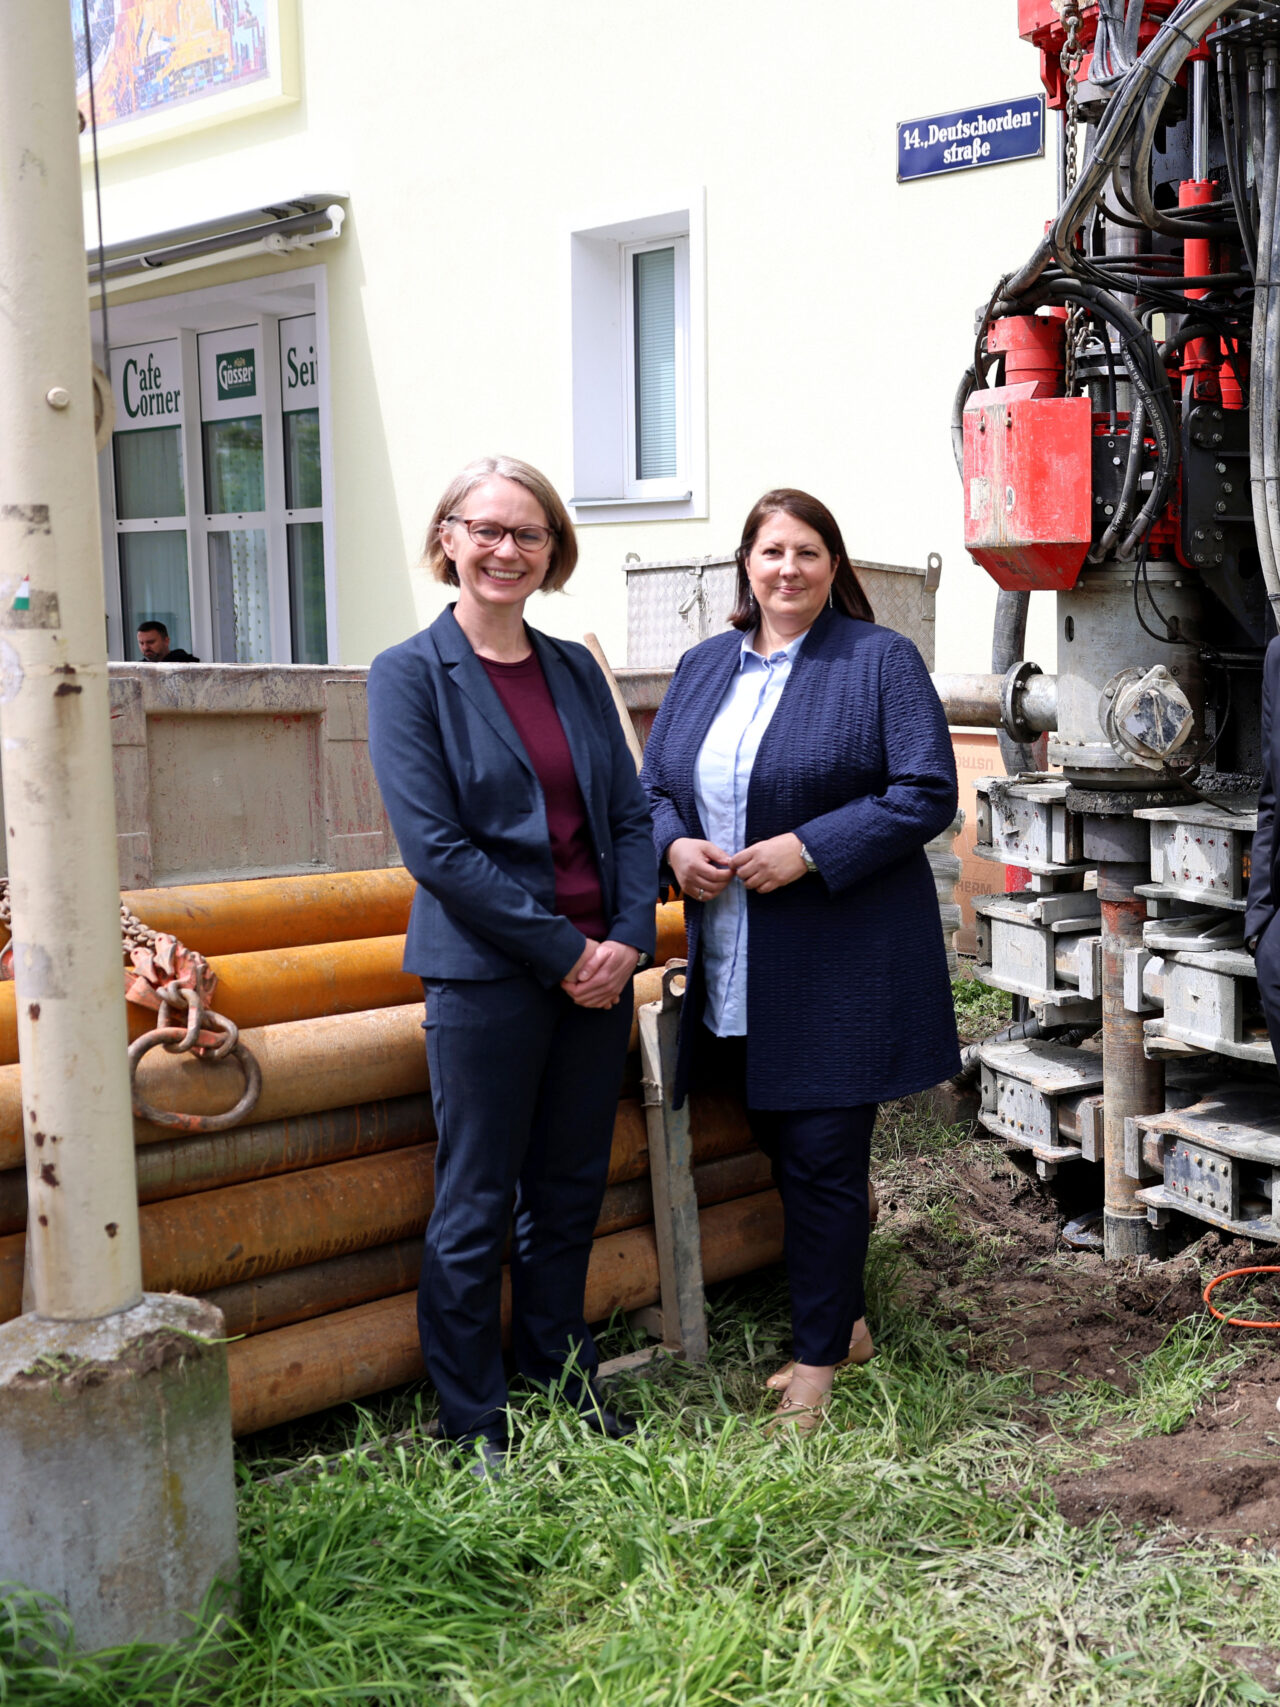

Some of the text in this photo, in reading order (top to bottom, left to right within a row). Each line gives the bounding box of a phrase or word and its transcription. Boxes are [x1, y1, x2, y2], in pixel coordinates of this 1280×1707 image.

[943, 137, 991, 164] straße
[218, 359, 254, 390] Gösser
[287, 346, 318, 388] Sei
[123, 353, 161, 418] Cafe
[957, 756, 994, 770] USTRO
[955, 880, 993, 894] HERM
